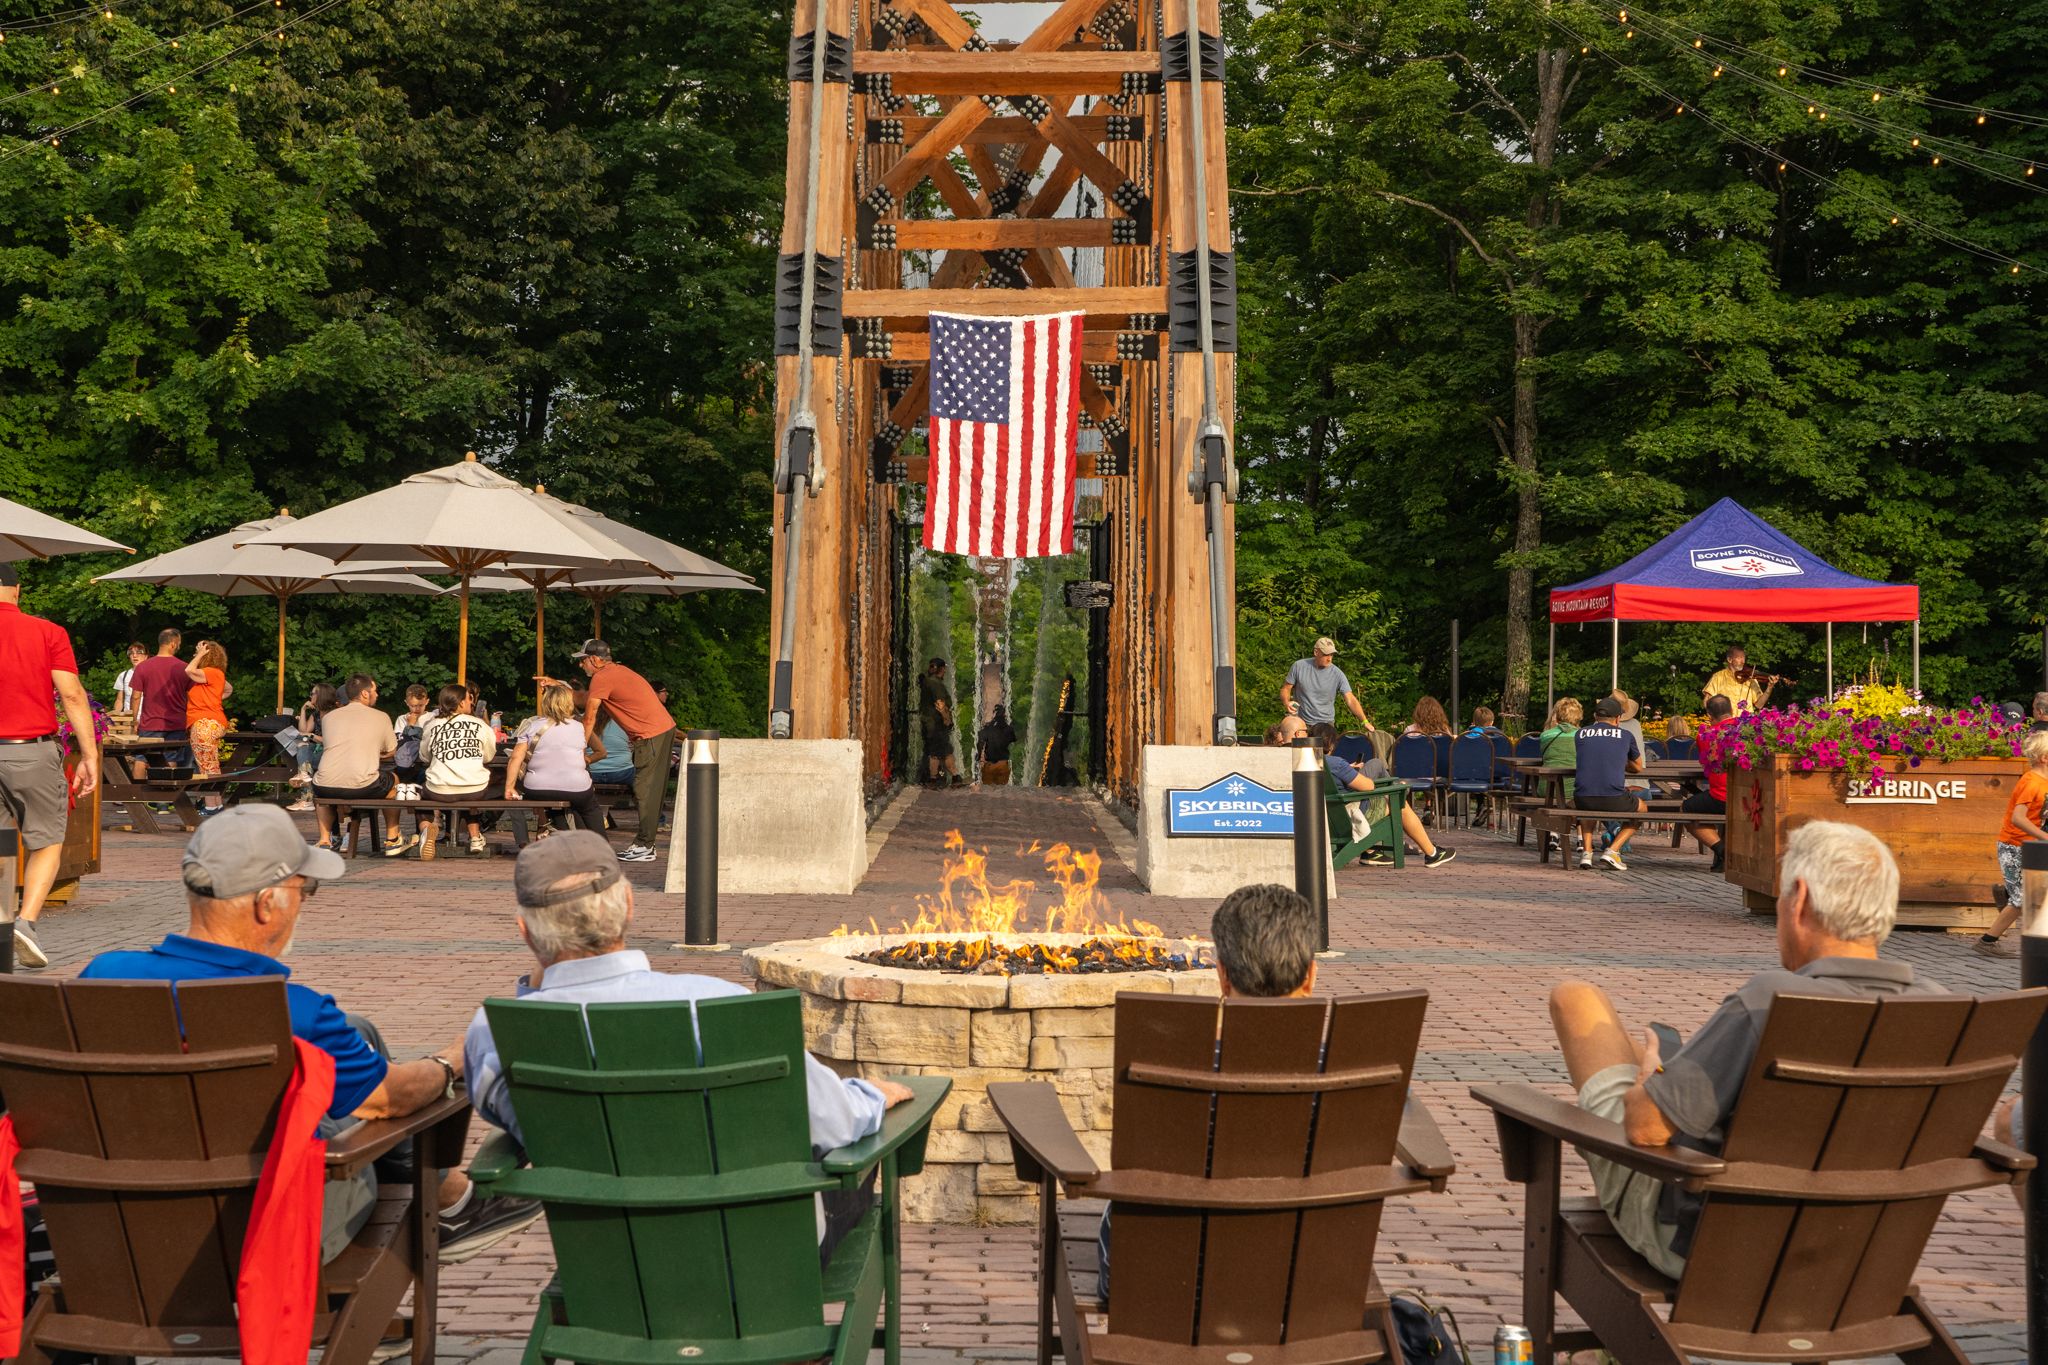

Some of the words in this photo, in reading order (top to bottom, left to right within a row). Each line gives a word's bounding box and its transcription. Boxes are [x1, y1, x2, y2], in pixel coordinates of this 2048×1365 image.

[1697, 550, 1735, 559] BOYNE
[1738, 549, 1793, 565] MOUNTAIN
[463, 729, 478, 738] IN
[1580, 728, 1622, 739] COACH
[434, 738, 481, 754] BIGGER
[433, 748, 483, 763] HOUSES
[1179, 801, 1294, 816] SKYBRIDGE
